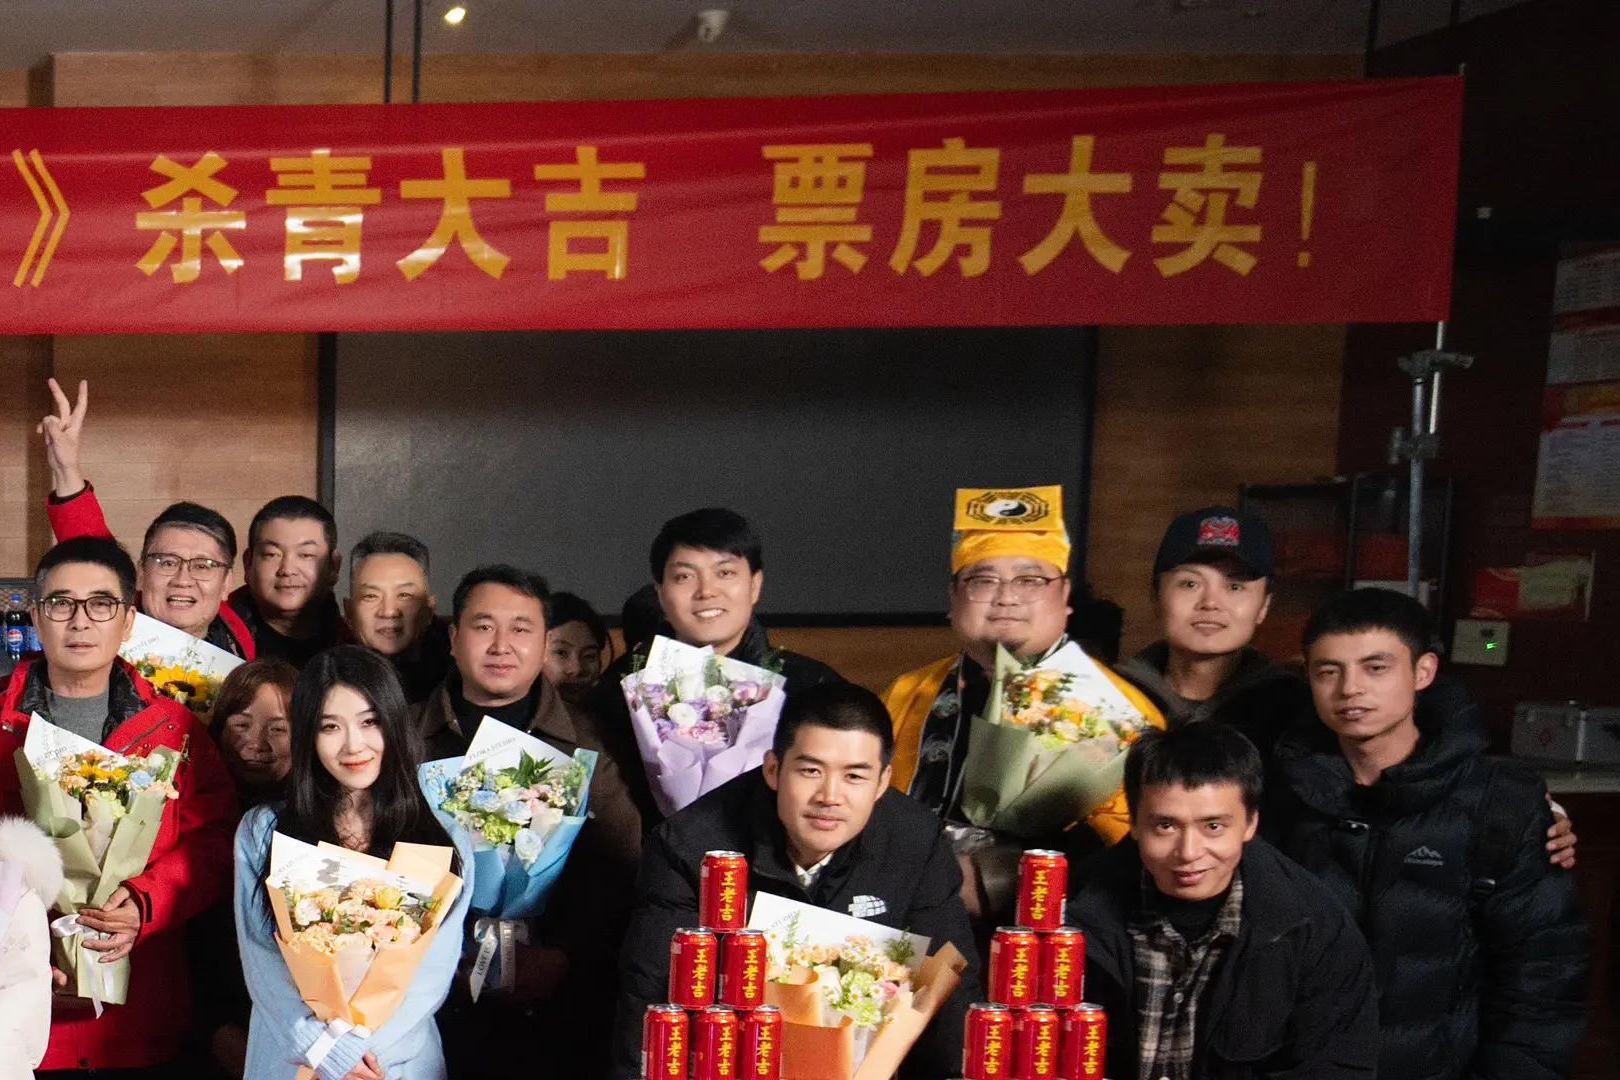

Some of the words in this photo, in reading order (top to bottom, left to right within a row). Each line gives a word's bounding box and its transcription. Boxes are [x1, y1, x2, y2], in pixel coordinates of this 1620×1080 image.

[720, 871, 736, 921] 王老吉
[1031, 870, 1049, 920] 王老吉
[691, 948, 708, 998] 王老吉
[742, 949, 759, 999] 王老吉
[1011, 948, 1029, 998] 王老吉
[1053, 947, 1071, 997] 王老吉
[667, 1026, 683, 1076] 王老吉
[718, 1026, 733, 1076] 王老吉
[756, 1025, 773, 1075] 王老吉
[984, 1024, 1002, 1074] 王老吉
[1035, 1025, 1052, 1075] 王老吉
[1083, 1025, 1100, 1075] 王老吉
